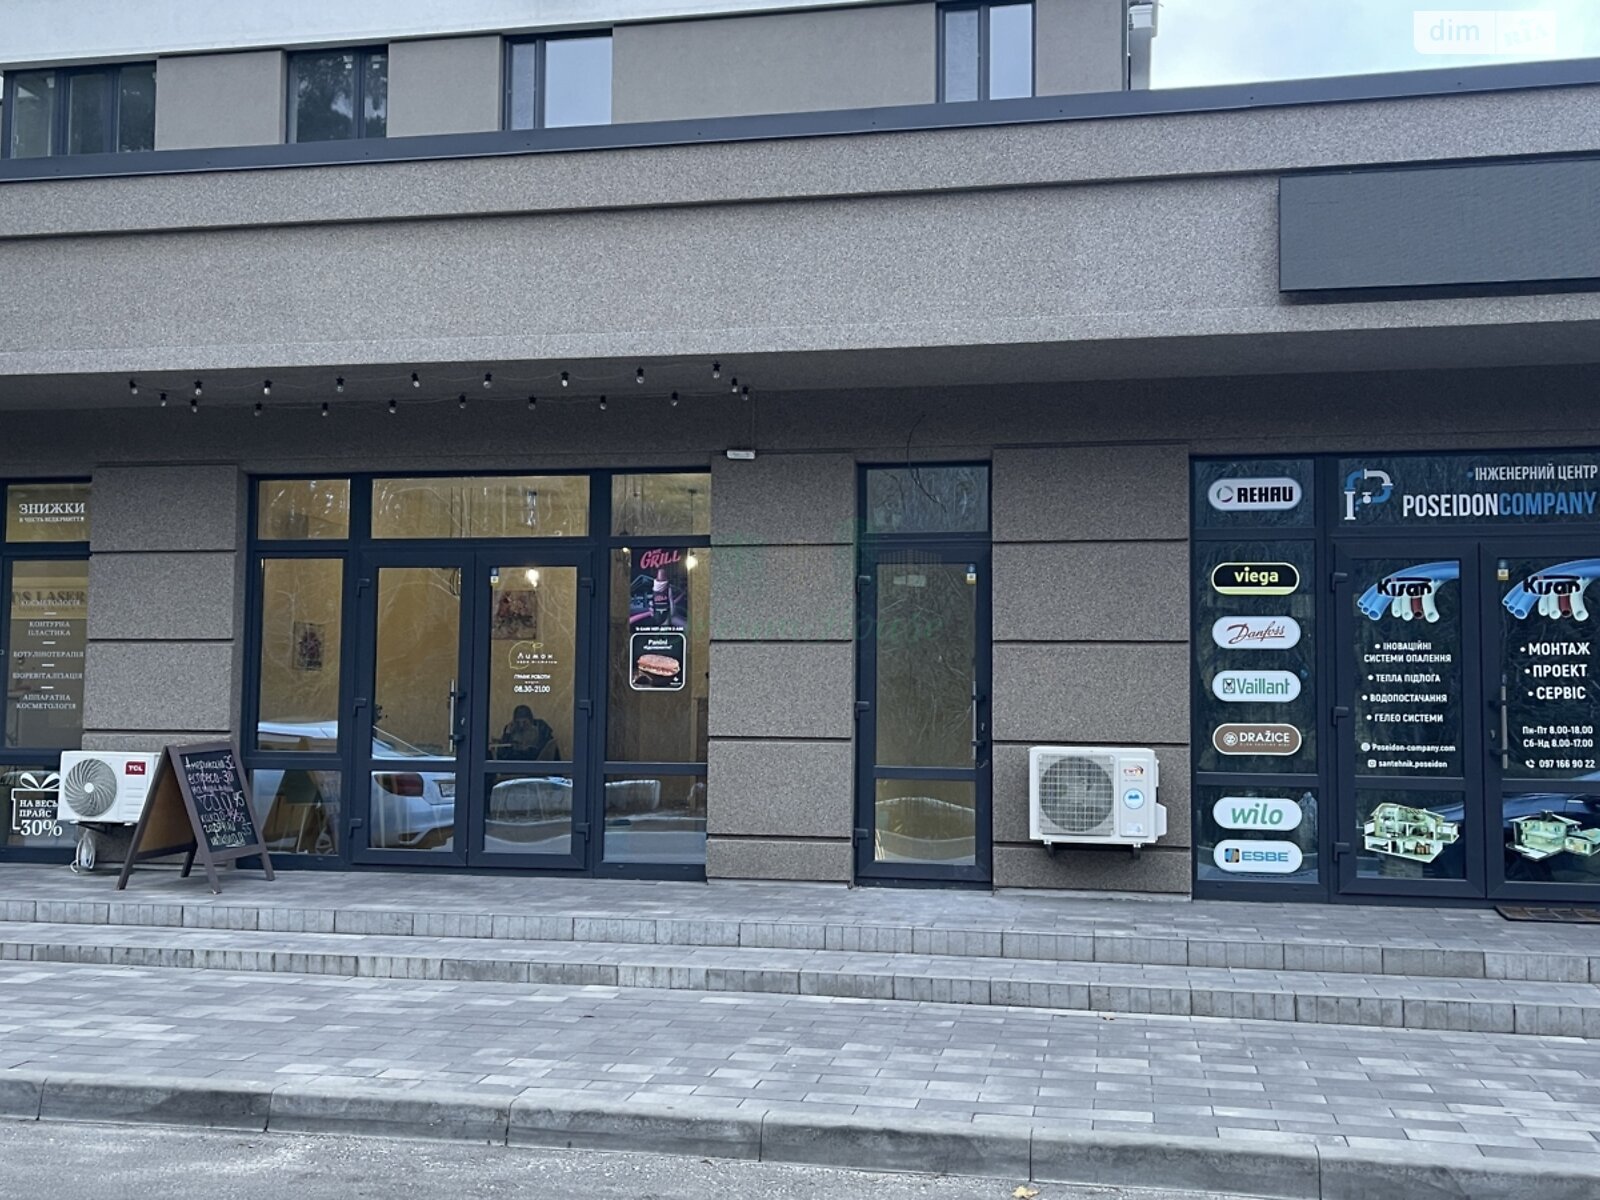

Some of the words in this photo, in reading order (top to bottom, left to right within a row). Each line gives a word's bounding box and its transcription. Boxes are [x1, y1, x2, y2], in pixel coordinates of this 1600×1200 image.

[1475, 463, 1555, 481] ІНЖЕНЕРНИЙ
[1558, 464, 1599, 481] ЦЕНТР
[1237, 486, 1293, 503] REHAU
[19, 502, 86, 515] ЗНИЖКИ
[640, 550, 681, 569] GRILL
[1234, 566, 1279, 586] viega
[1227, 620, 1286, 644] Danfoss
[1383, 640, 1432, 651] ІНОВАЦІЙНІ
[1528, 642, 1591, 655] МОНТАЖ
[1363, 654, 1404, 663] СИСТЕМИ
[1405, 654, 1452, 663] ОПАЛЕННЯ
[1533, 664, 1588, 677] ПРОЕКТ
[1375, 674, 1402, 683] ТЕПЛА
[1404, 674, 1441, 684] ПІДЛОГА
[1236, 678, 1290, 695] Vaillant
[1536, 686, 1587, 699] СЕРВІС
[1369, 694, 1448, 703] ВОДОПОСТАЧАННЯ
[1374, 713, 1401, 722] ГЕЛЕО
[1402, 713, 1444, 723] СИСТЕМИ
[1240, 730, 1290, 743] DRAŽICE
[1549, 726, 1594, 735] 8.00-18.00
[1523, 739, 1550, 749] Сб-Нд
[1551, 739, 1594, 748] 8.00-17.00
[1538, 759, 1554, 769] 097
[1556, 759, 1571, 769] 166
[1572, 759, 1584, 769] 90
[1584, 759, 1596, 769] 22
[20, 800, 35, 808] НА
[36, 799, 58, 808] ВЕСЬ
[19, 808, 52, 817] ПРАЙС
[1231, 803, 1283, 825] wilo
[20, 820, 63, 837] 30%
[1241, 851, 1289, 862] ESBE
